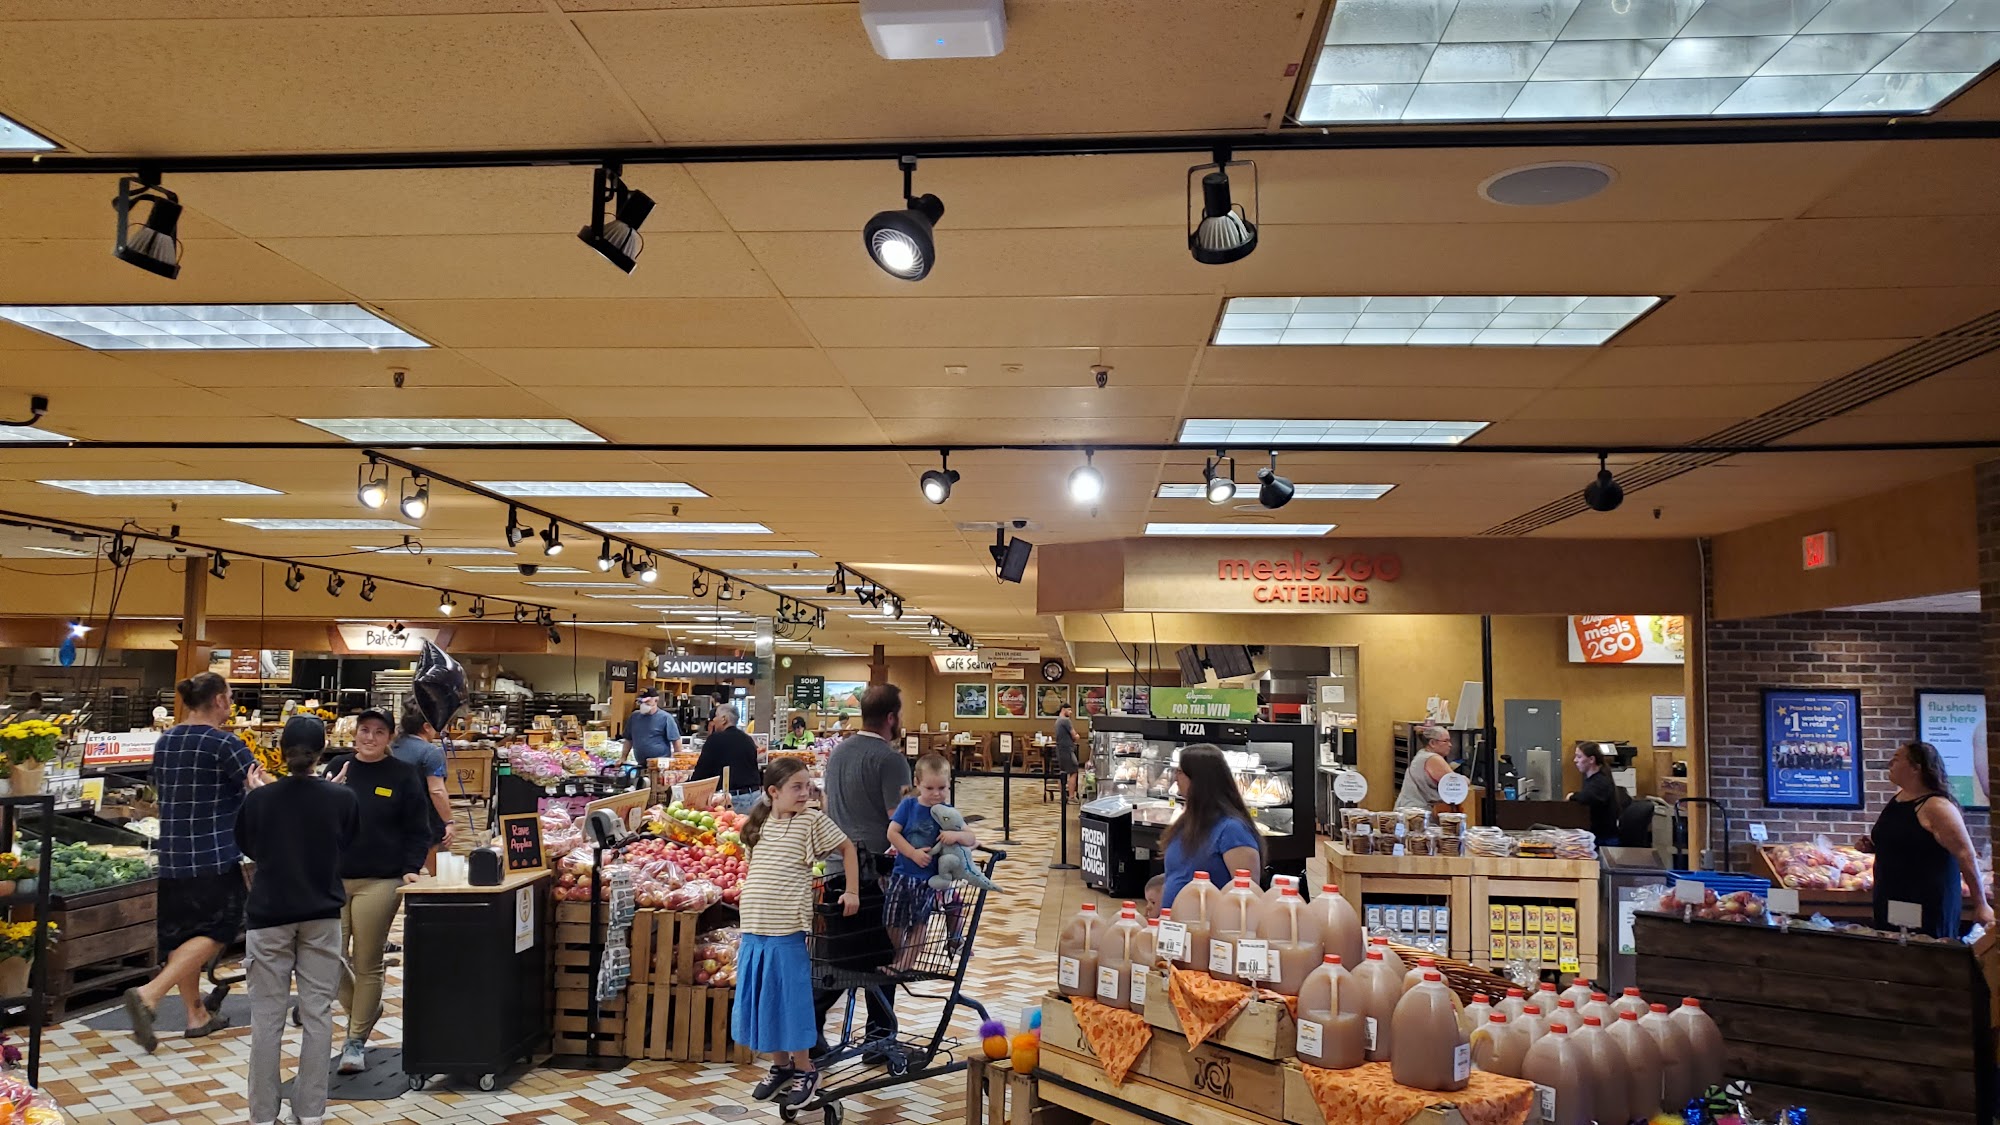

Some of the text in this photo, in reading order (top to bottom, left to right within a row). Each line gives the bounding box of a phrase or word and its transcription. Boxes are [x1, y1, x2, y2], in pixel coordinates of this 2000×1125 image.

[1218, 551, 1401, 581] meals 2GO
[1253, 584, 1370, 604] CATERING
[1584, 618, 1631, 641] meals
[366, 630, 410, 648] Bakery
[1587, 632, 1636, 660] 2GO
[611, 665, 628, 677] SALADS
[663, 661, 753, 675] SANDWICHES
[945, 658, 963, 671] Café
[1185, 690, 1213, 703] Wegmans
[1172, 703, 1231, 717] FOR THE WIN
[1928, 701, 1977, 712] flu shots
[1928, 713, 1976, 723] are here
[1180, 723, 1205, 735] PIZZA
[511, 824, 530, 836] Rave
[1081, 826, 1106, 847] FROZEN
[510, 838, 532, 852] Apples
[1084, 842, 1102, 861] PIZZA
[1081, 856, 1106, 877] DOUGH
